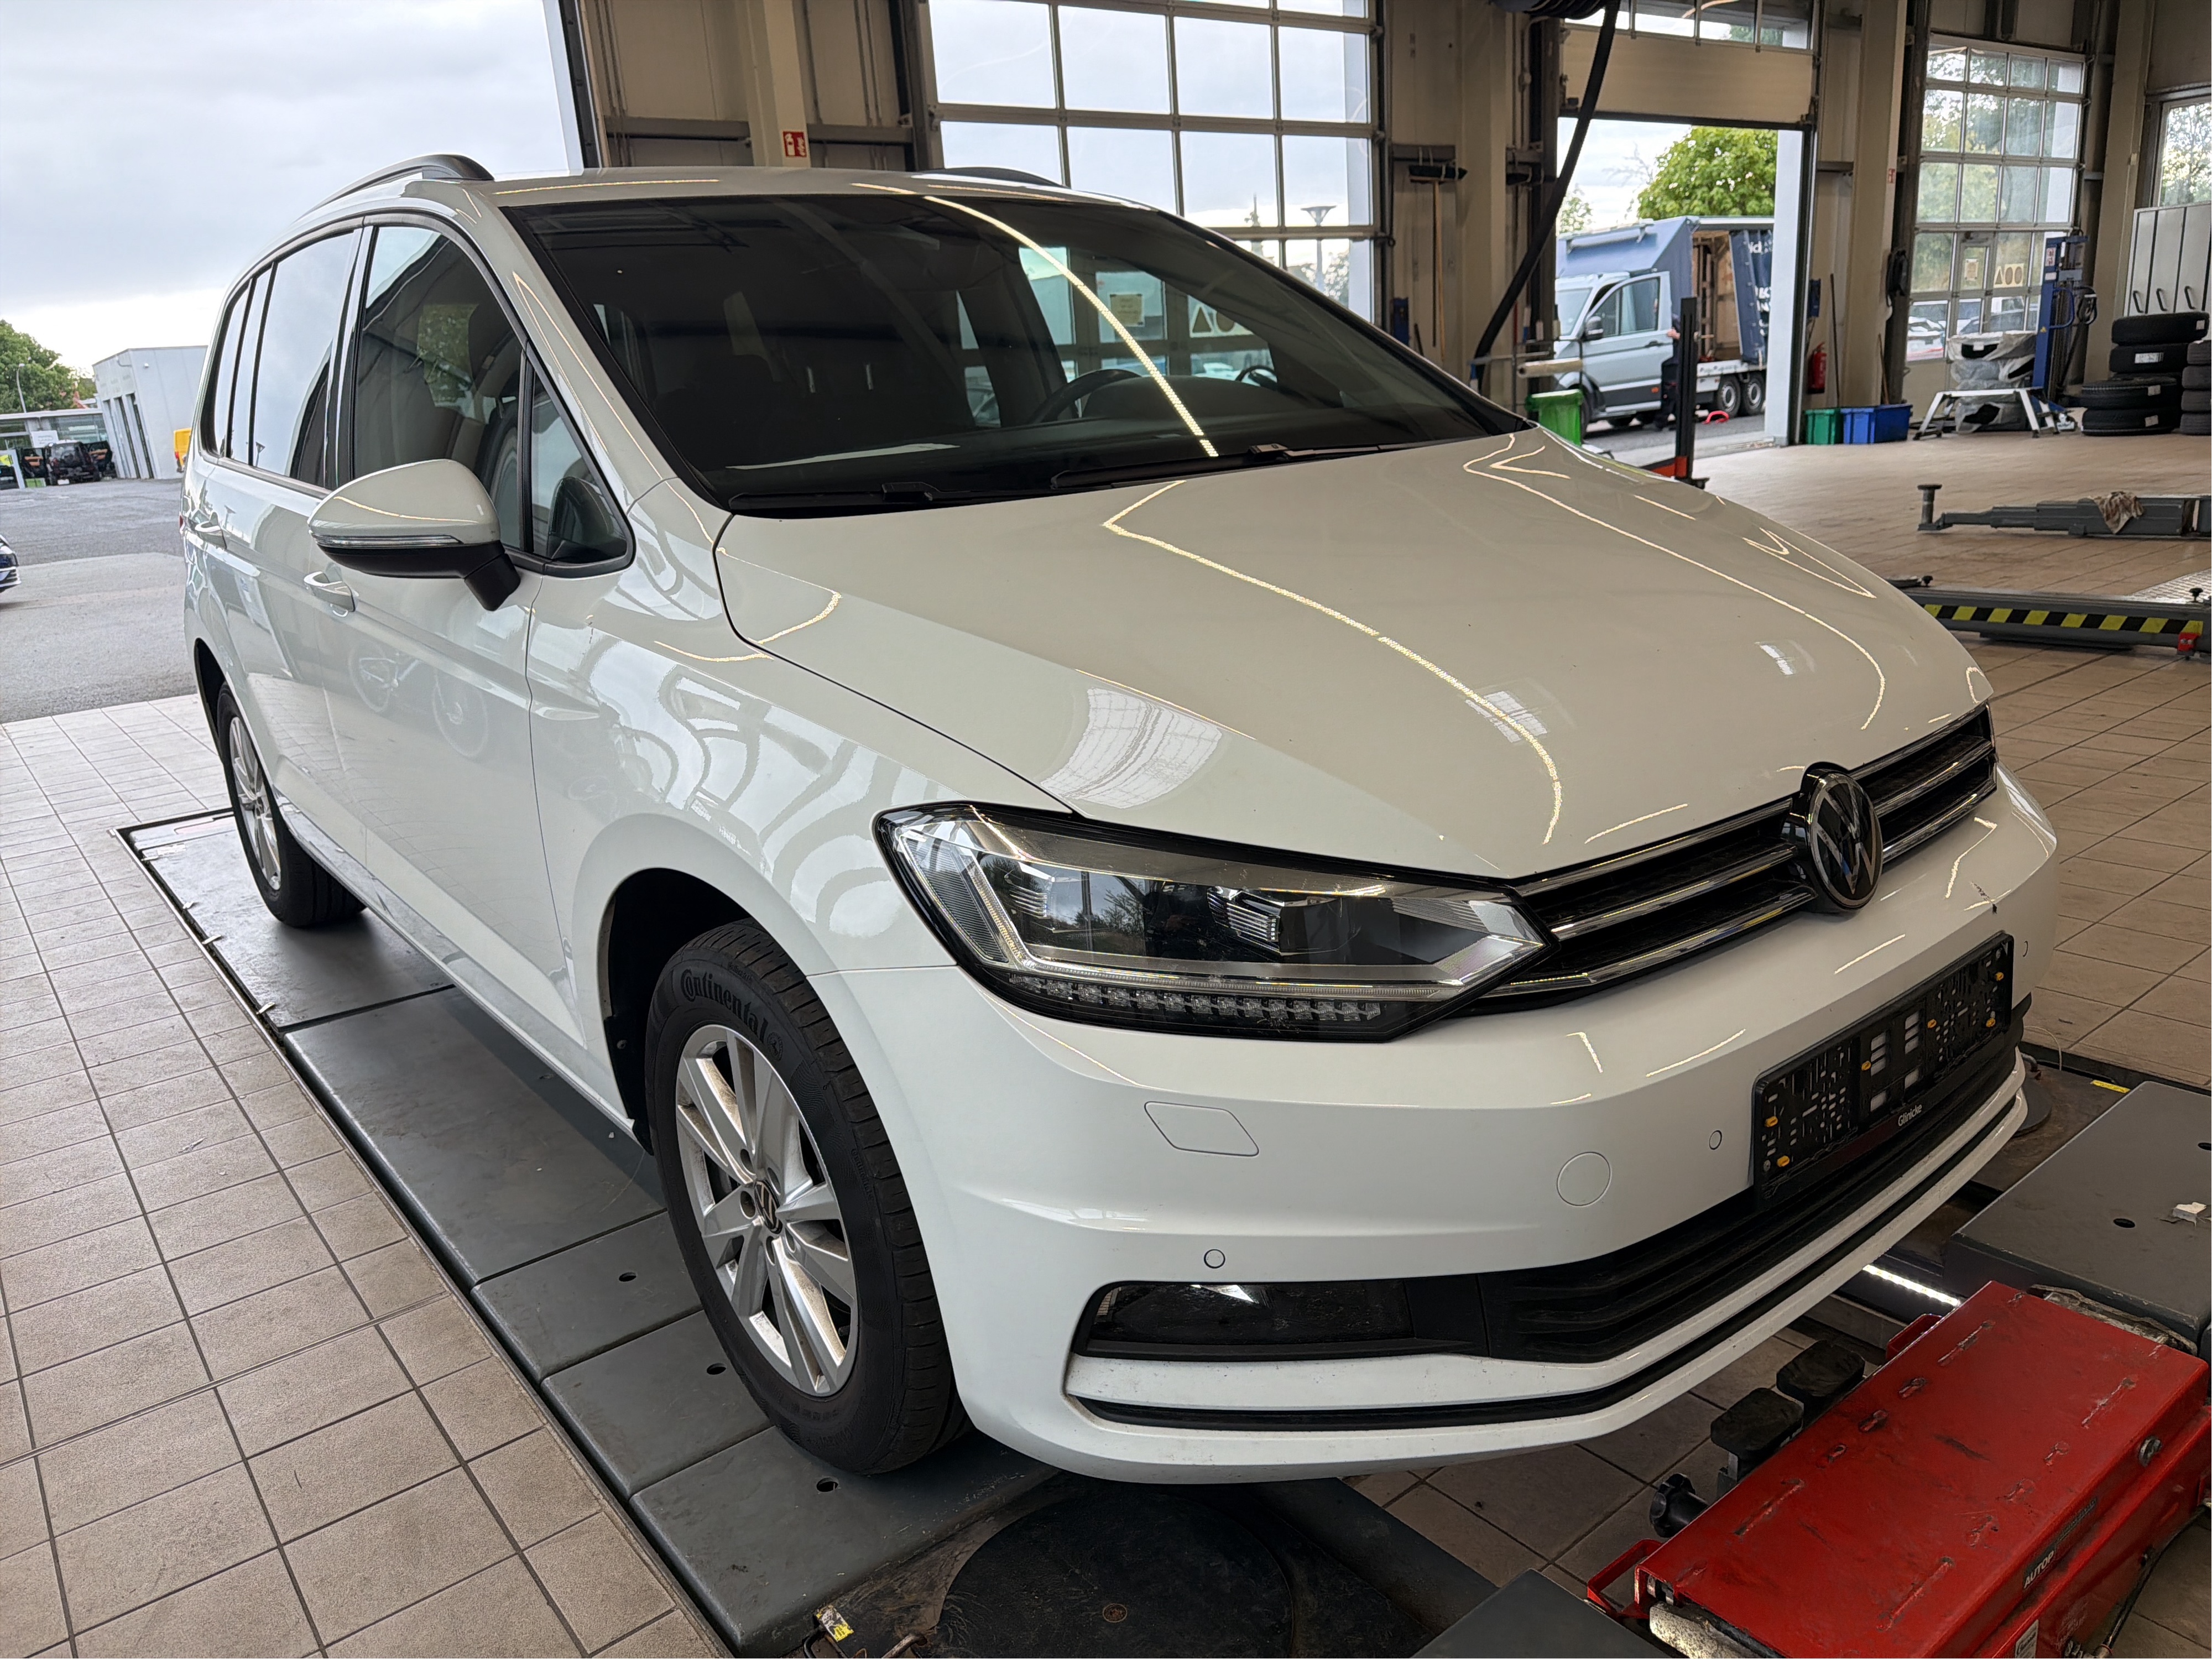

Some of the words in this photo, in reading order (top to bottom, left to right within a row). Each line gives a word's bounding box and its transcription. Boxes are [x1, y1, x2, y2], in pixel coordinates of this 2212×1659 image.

[680, 968, 769, 1044] Continental
[1898, 1104, 1922, 1126] Glinicke
[2023, 1550, 2055, 1589] AUTOP
